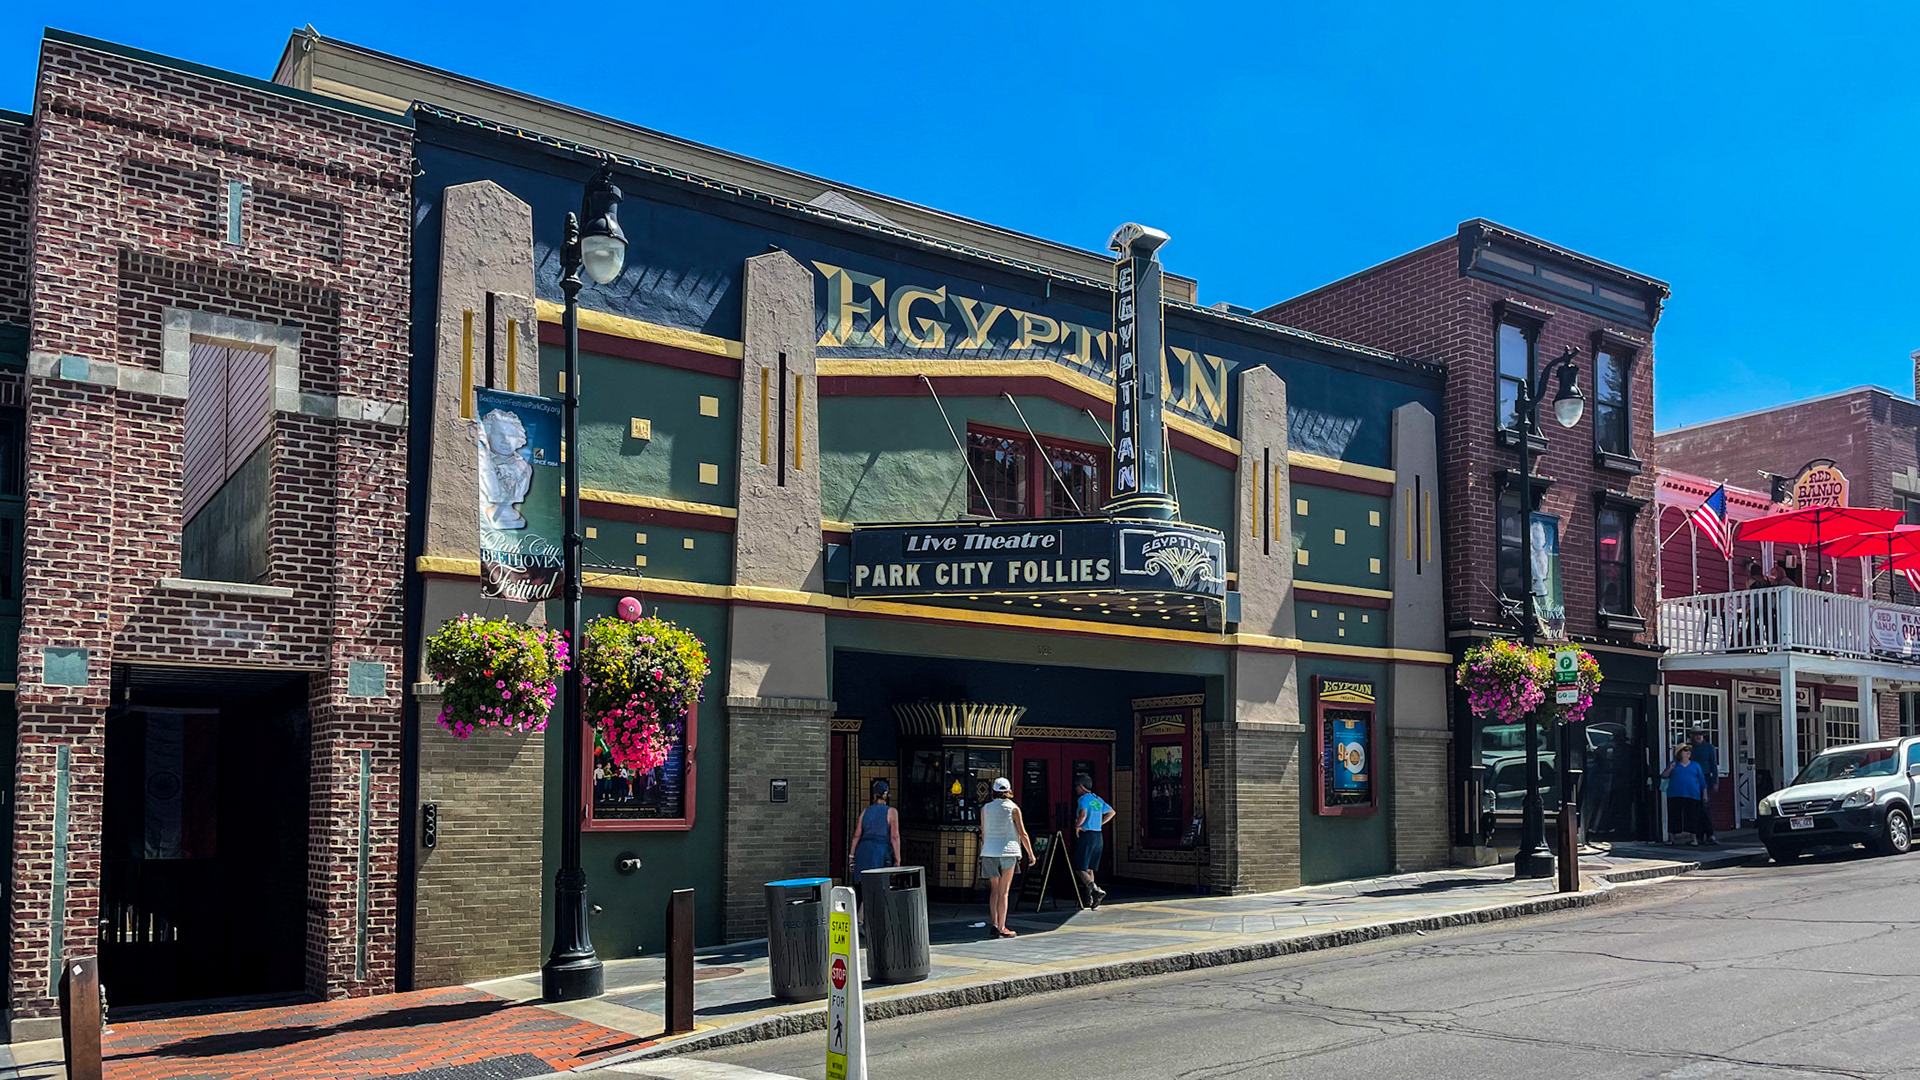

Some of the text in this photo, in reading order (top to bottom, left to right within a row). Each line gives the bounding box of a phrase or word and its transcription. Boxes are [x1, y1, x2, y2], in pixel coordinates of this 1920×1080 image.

[812, 260, 1239, 427] EGYPTN
[1118, 267, 1136, 491] EGYPTIAN
[479, 394, 561, 415] BeethovenFestivalParkCity.org
[1809, 470, 1831, 483] RED
[1798, 483, 1842, 498] BANJO
[484, 530, 560, 562] Park City
[906, 532, 1055, 551] Live Theatre
[1141, 536, 1210, 558] EGYPTIAN
[482, 549, 564, 568] BEETHOVEN
[855, 558, 1111, 587] PARK CITY FOLLIES
[483, 564, 559, 599] Festival
[1877, 612, 1891, 622] RED
[1563, 658, 1570, 667] P
[1558, 672, 1564, 681] 3
[1323, 680, 1372, 695] EGYPTIAN
[1144, 714, 1182, 725] EGYPTIAN
[783, 918, 826, 929] RECYCLE
[832, 921, 848, 932] STATE
[834, 934, 845, 944] LAW
[832, 967, 846, 981] STOP
[832, 995, 845, 1008] FOR
